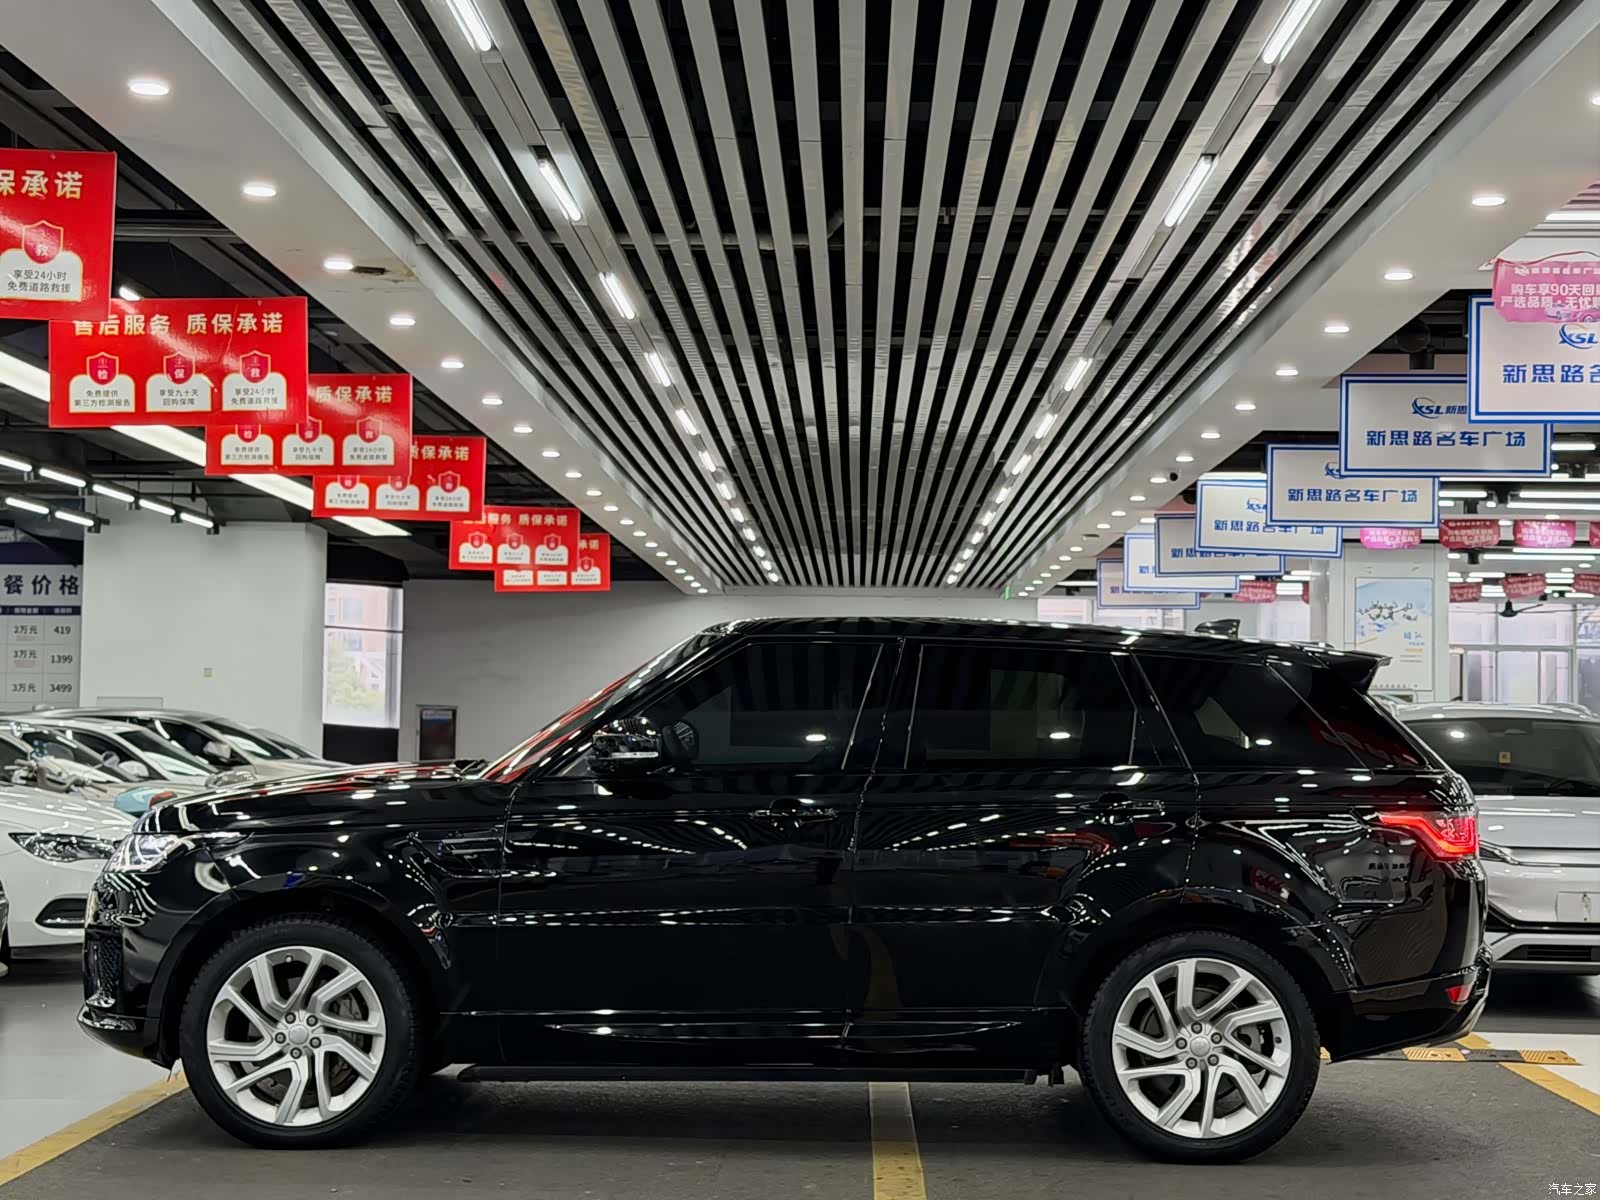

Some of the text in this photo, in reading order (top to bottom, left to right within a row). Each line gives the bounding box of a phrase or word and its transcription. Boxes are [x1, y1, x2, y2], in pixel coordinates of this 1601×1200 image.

[13, 269, 67, 281] 享受24小时
[7, 281, 71, 293] 免费道路救援
[187, 312, 284, 334] 质保承诺
[314, 385, 393, 404] 质保承诺
[1366, 430, 1526, 447] 新思路名车广场
[1287, 488, 1418, 503] 新思路名车广场
[4, 574, 80, 596] 餐价格
[53, 626, 71, 635] 419
[51, 655, 73, 664] 1399
[49, 683, 72, 693] 3499
